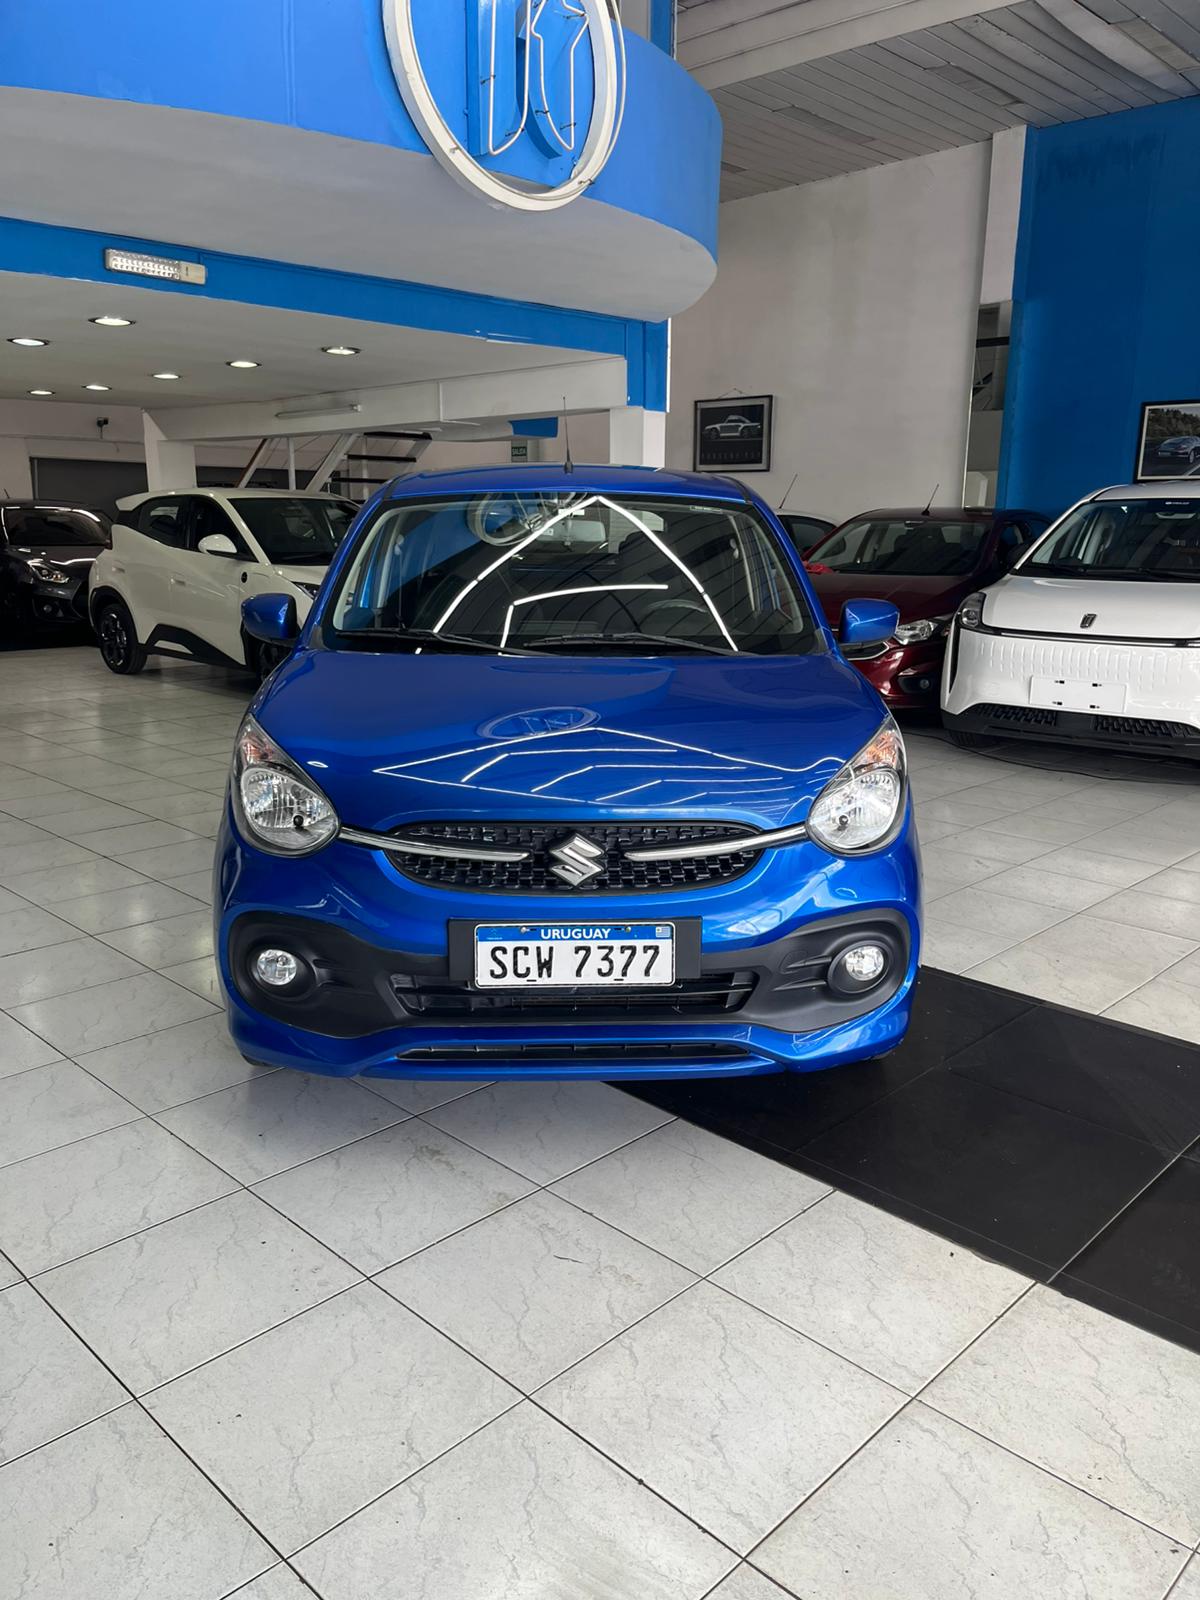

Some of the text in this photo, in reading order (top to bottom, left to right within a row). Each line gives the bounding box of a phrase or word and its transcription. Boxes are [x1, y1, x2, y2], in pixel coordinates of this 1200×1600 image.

[540, 928, 612, 940] URUGUAY
[489, 945, 660, 979] SCW 7377
